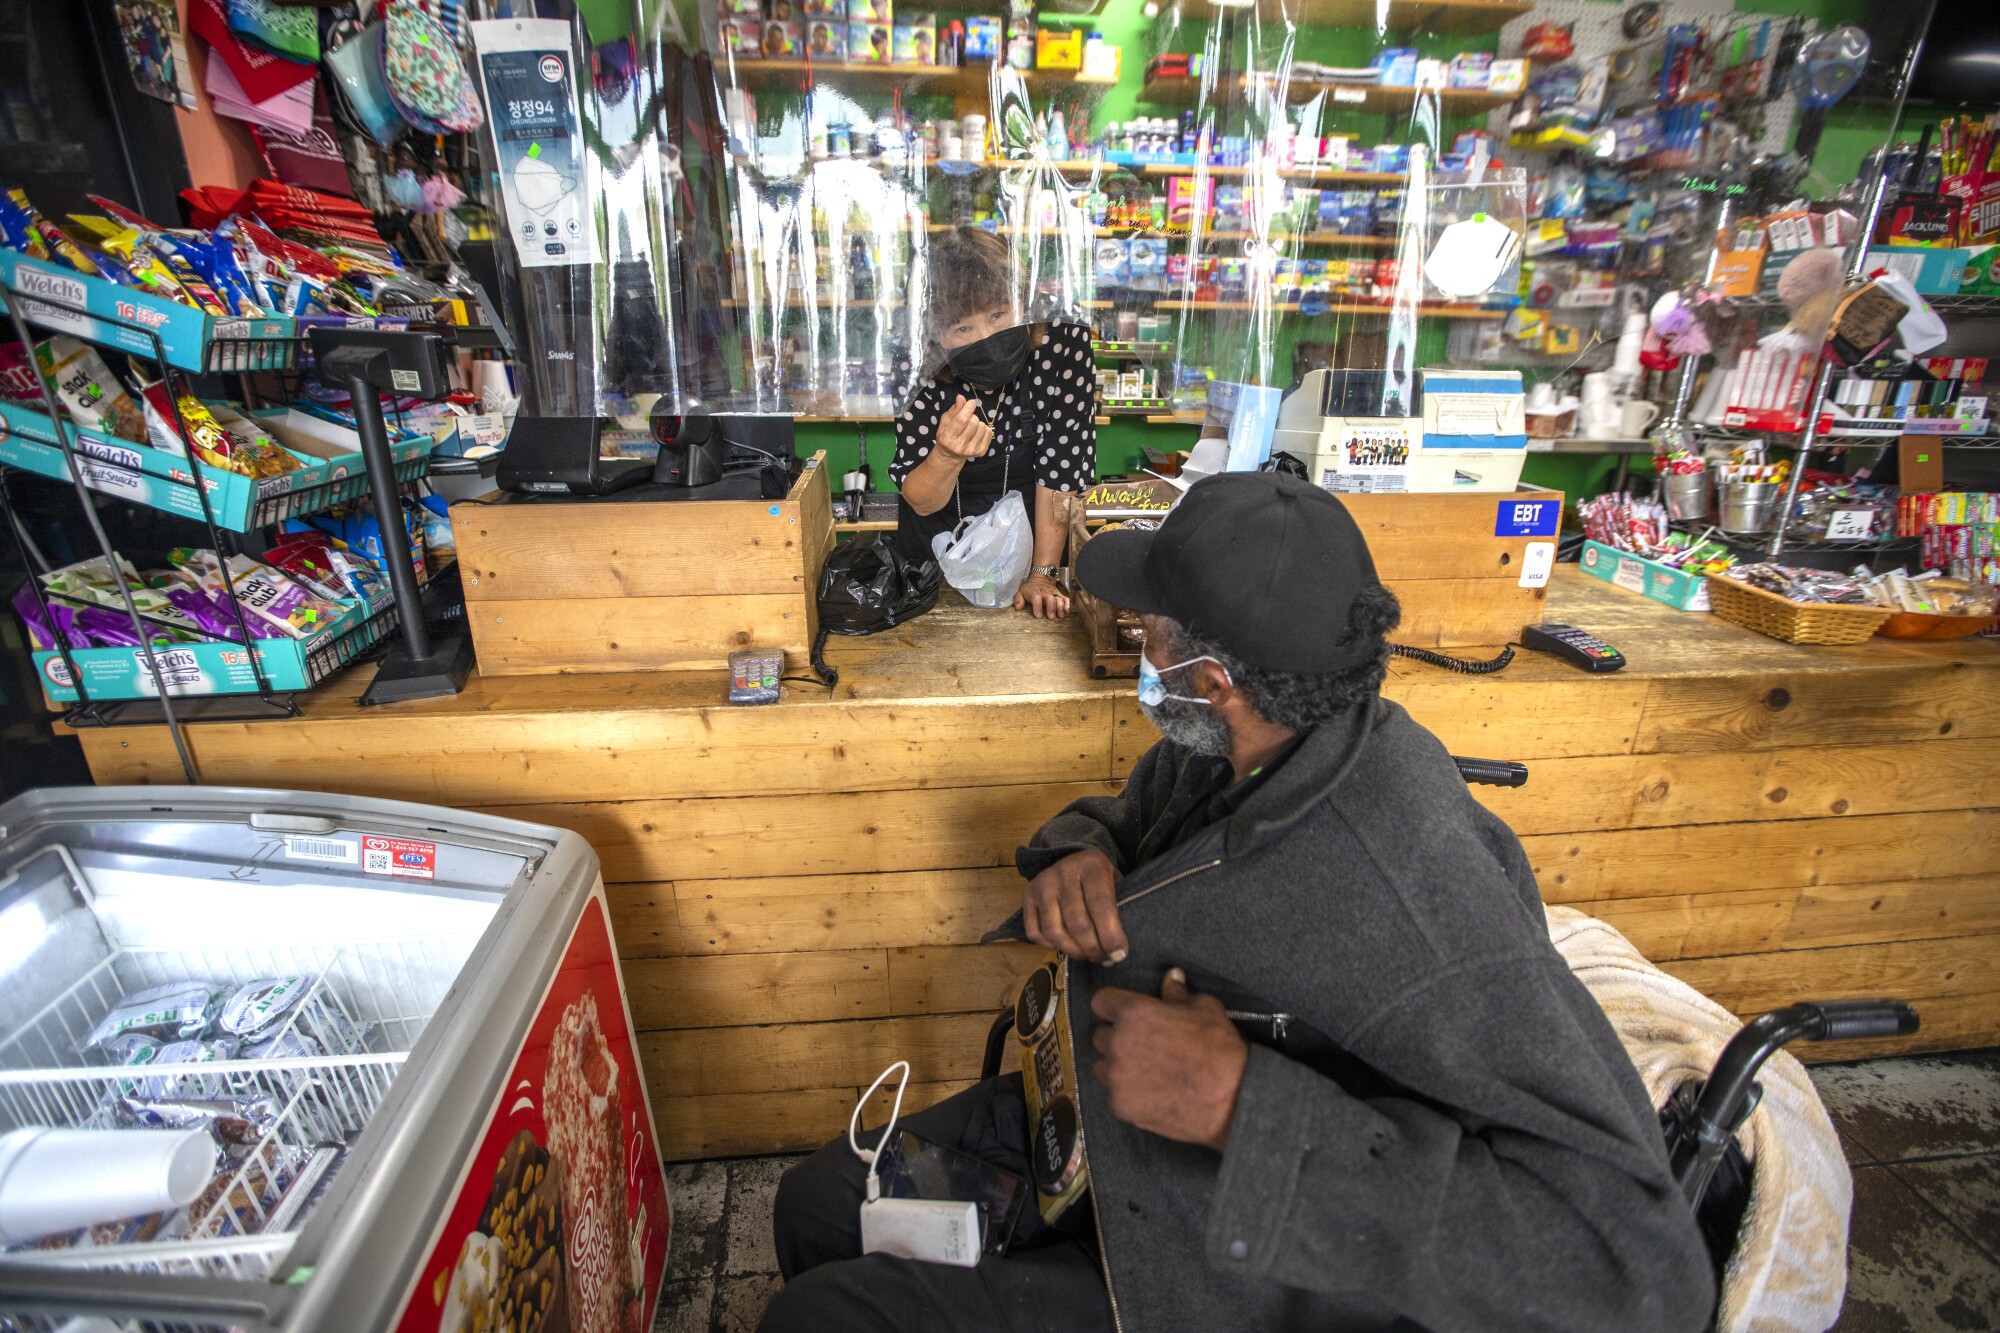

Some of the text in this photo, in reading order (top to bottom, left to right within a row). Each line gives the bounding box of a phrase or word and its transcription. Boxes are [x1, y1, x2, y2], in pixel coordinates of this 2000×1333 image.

[508, 100, 554, 119] 청정94
[510, 117, 557, 125] CHEONGJEONG94
[1681, 177, 1718, 192] Thank
[524, 225, 533, 233] 3D
[1100, 216, 1119, 229] for
[1129, 220, 1149, 232] your
[1901, 222, 1926, 232] JACK
[20, 273, 83, 300] Welch's
[117, 302, 135, 319] 16
[385, 303, 435, 321] HERSHEY'S
[215, 325, 249, 339] Welch's
[62, 370, 92, 395] snak
[81, 443, 140, 469] Welch's
[81, 466, 138, 488] Fruit Snacks
[259, 479, 291, 498] Welch's
[1087, 487, 1155, 507] Always
[1513, 504, 1543, 522] EBT
[236, 579, 267, 601] snak
[250, 586, 278, 608] club
[220, 652, 238, 664] 16
[172, 673, 200, 684] Snacks
[1024, 982, 1039, 1026] X-BASS
[1042, 1110, 1062, 1172] X-BASS
[580, 1217, 603, 1299] GOOD
